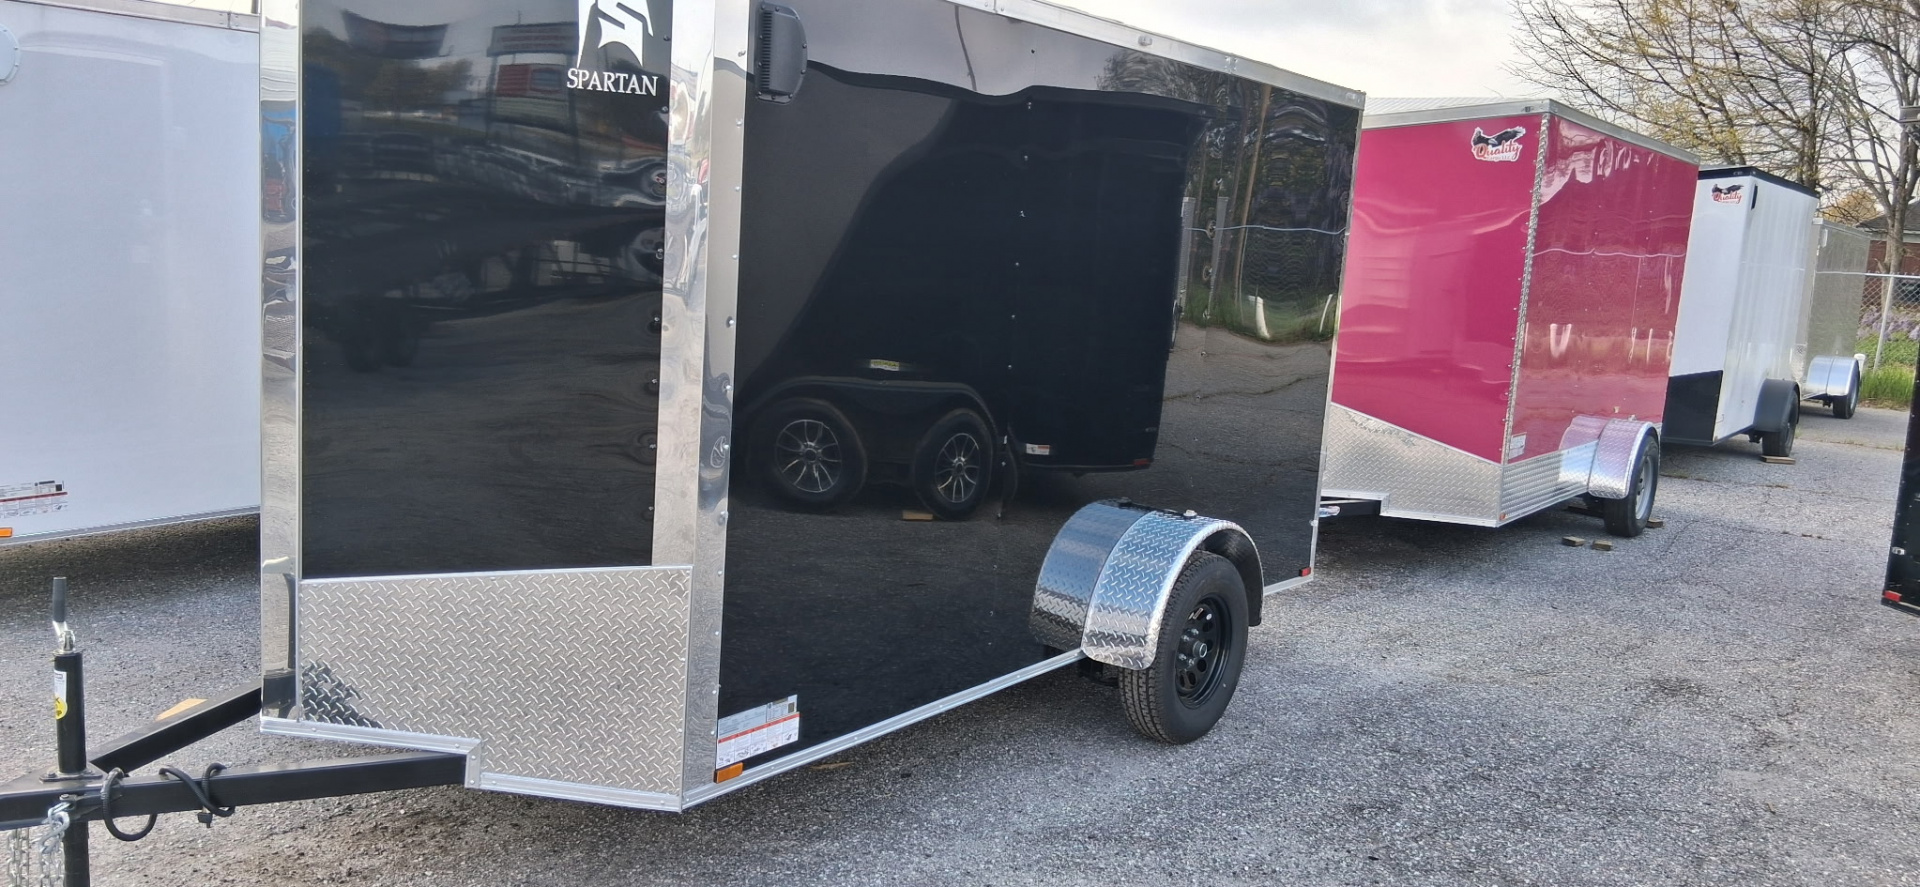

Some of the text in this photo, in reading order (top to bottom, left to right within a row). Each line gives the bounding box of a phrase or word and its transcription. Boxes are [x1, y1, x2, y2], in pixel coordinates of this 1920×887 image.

[566, 67, 659, 97] SPARTAN
[1473, 139, 1521, 160] Quality
[1711, 190, 1742, 204] Quality
